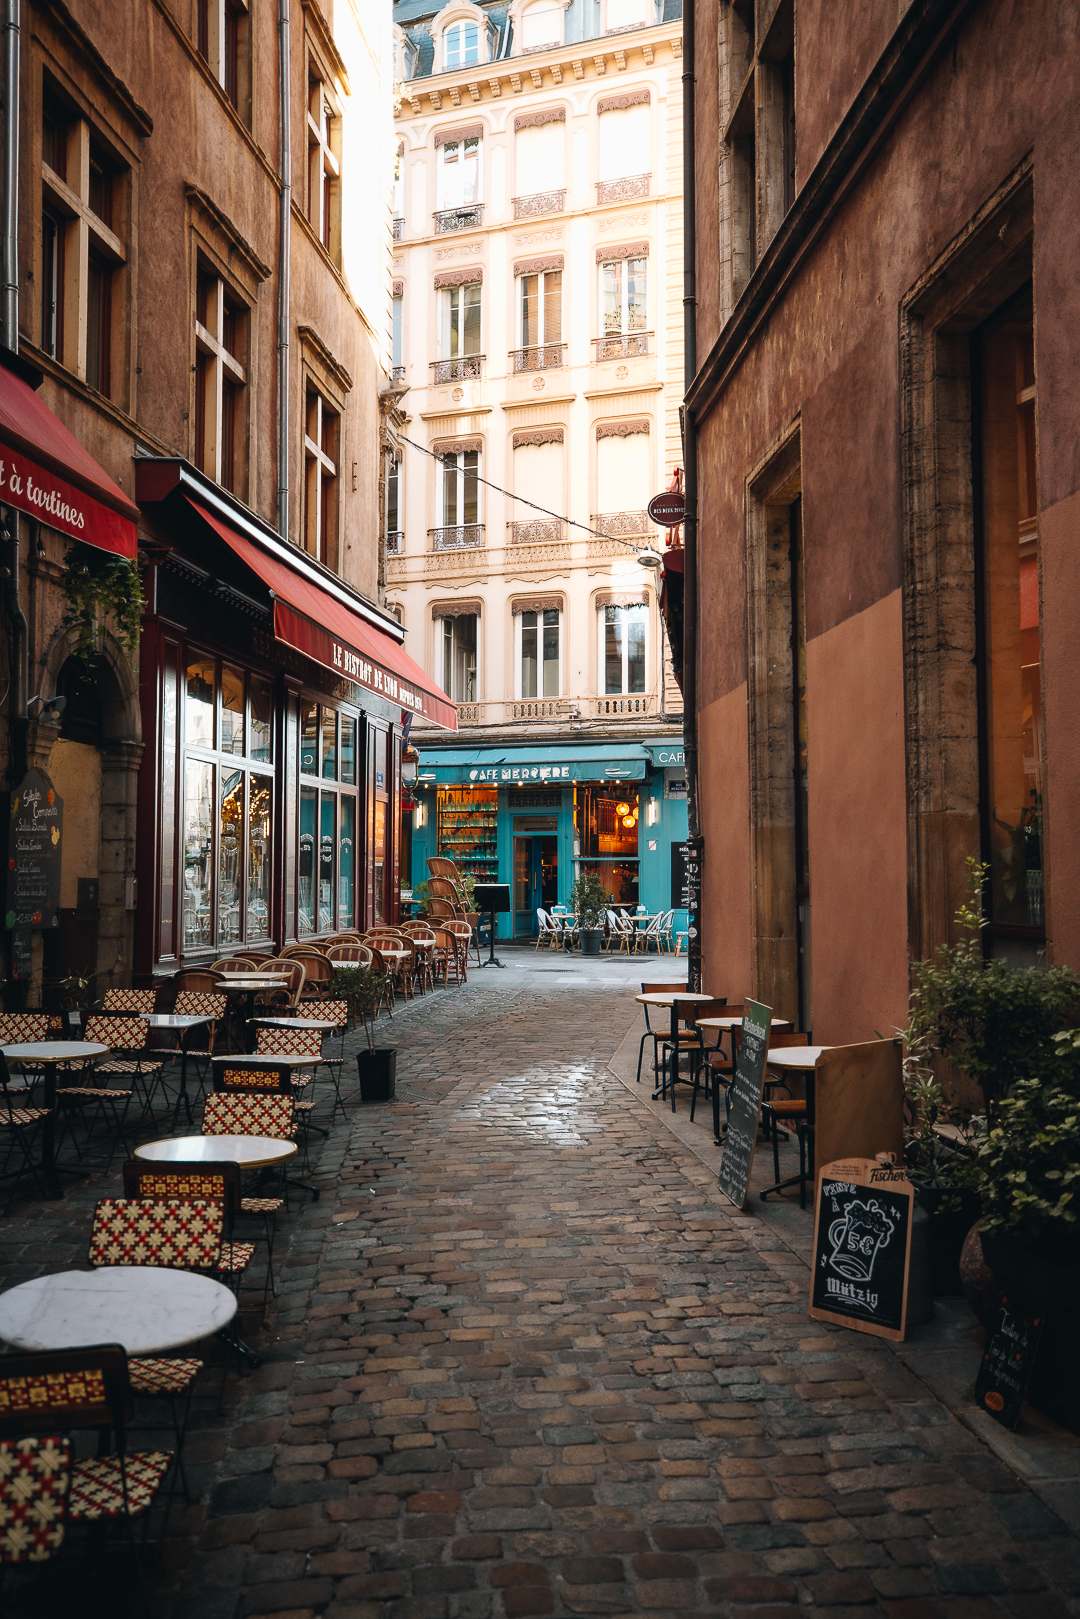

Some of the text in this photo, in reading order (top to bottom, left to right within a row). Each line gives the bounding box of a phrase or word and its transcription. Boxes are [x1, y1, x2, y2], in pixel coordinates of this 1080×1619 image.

[27, 477, 85, 529] tartines
[332, 643, 342, 668] LE
[344, 650, 372, 684] BISTROT
[374, 668, 383, 690] DE
[384, 674, 398, 699] LYON
[744, 1016, 766, 1040] Heineken
[869, 1167, 906, 1184] Fischer
[823, 1182, 857, 1197] PINTE
[847, 1231, 874, 1255] 5€
[825, 1277, 878, 1309] Mützig
